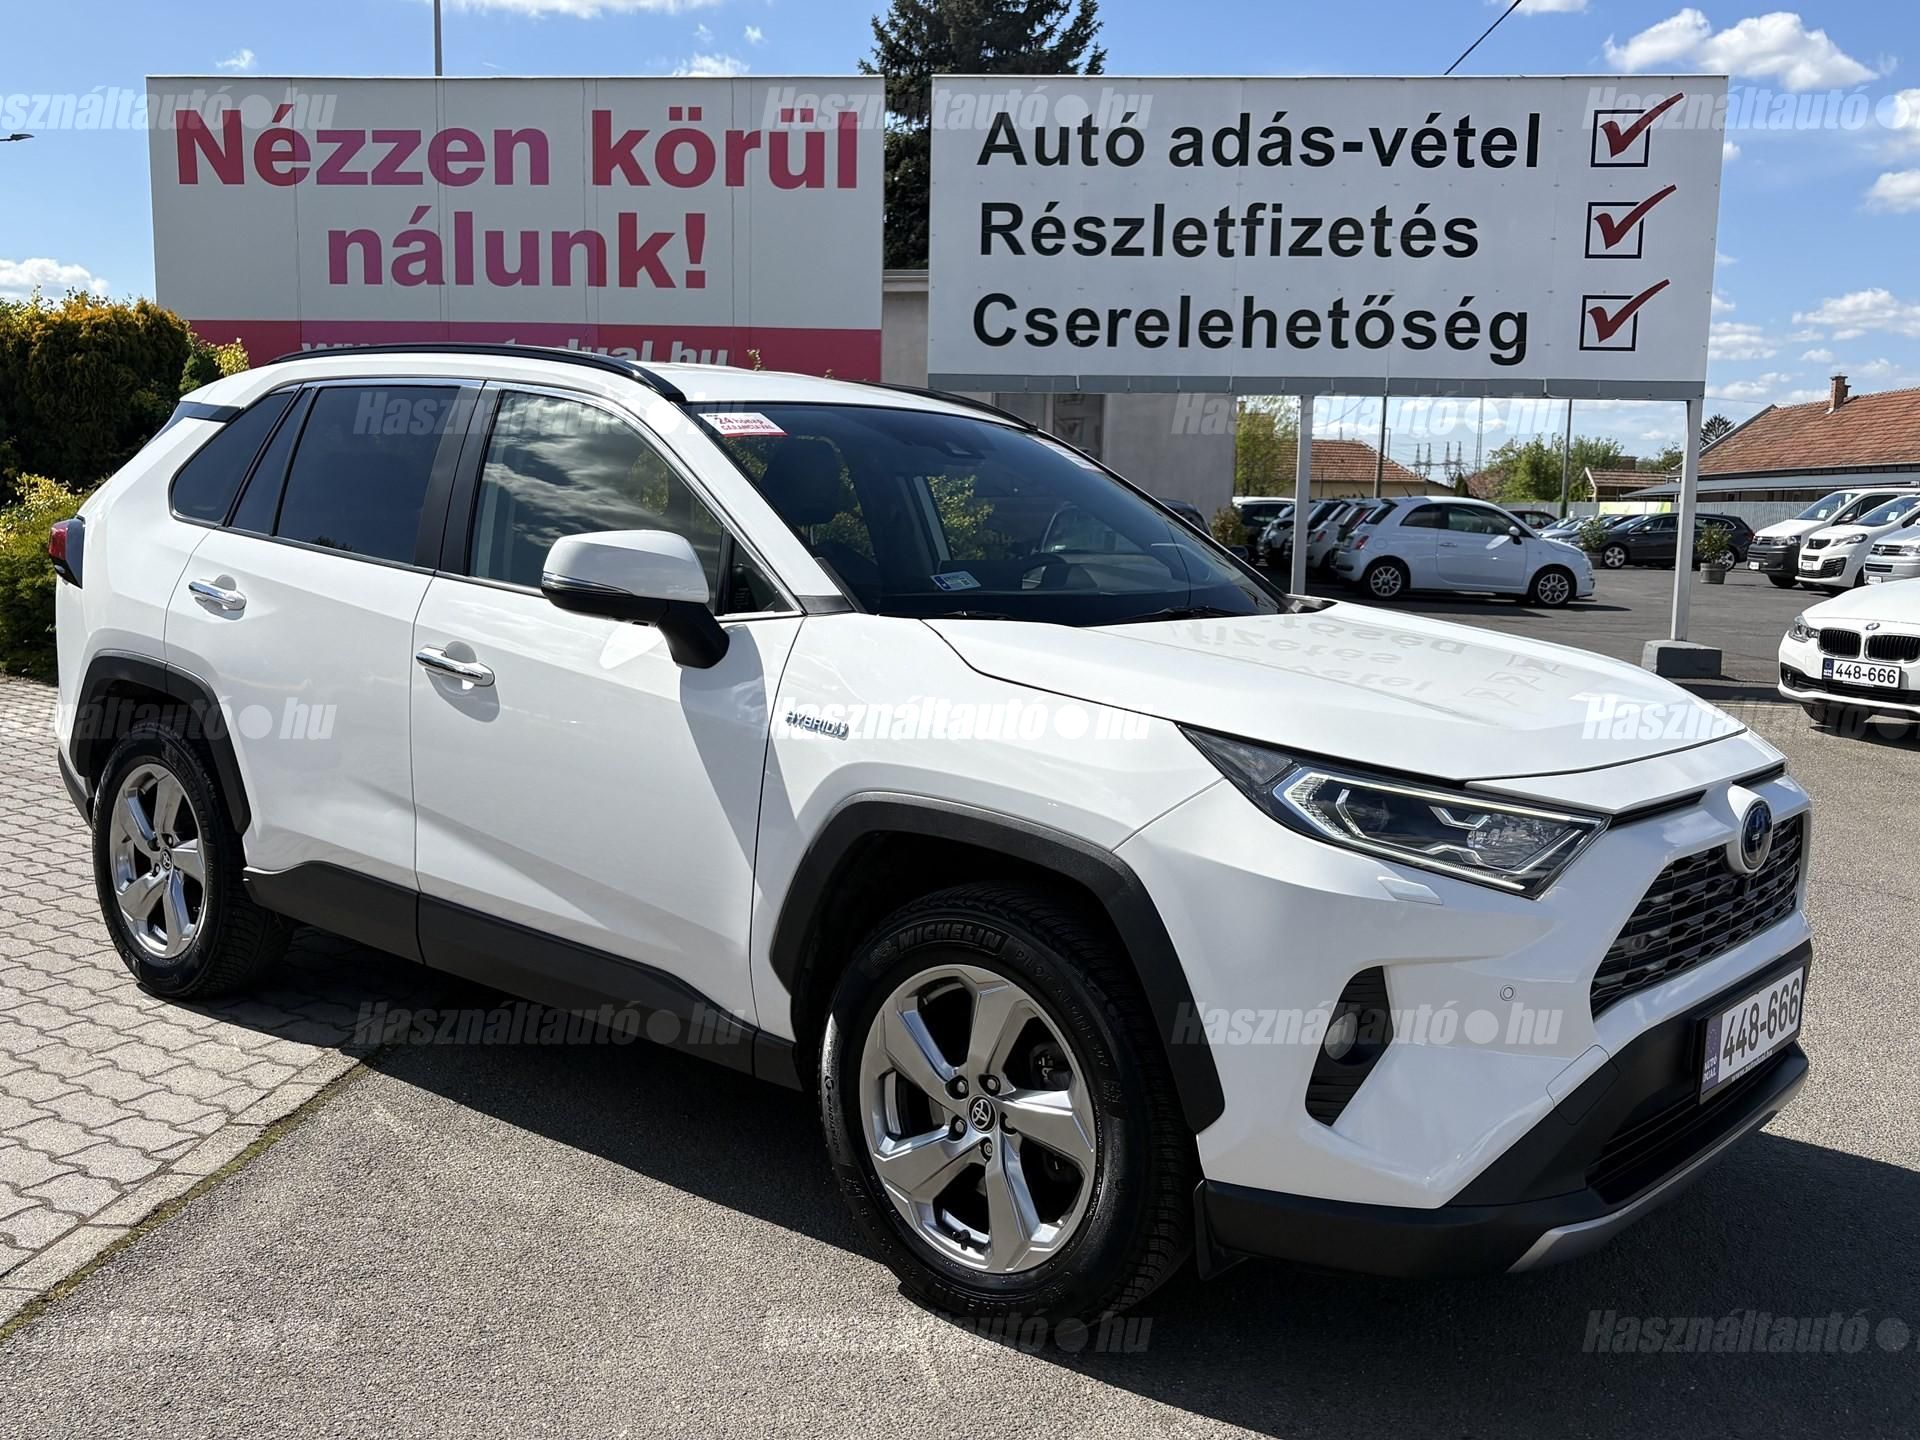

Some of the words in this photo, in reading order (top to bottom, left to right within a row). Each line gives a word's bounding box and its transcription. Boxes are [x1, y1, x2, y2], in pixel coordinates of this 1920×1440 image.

[176, 105, 549, 186] Nézzen
[593, 107, 858, 189] körül
[976, 111, 1145, 168] Autó
[1168, 111, 1541, 169] adás-vétel
[329, 206, 706, 289] nálunk!
[980, 201, 1479, 259] Részletfizetés
[973, 292, 1528, 366] Cserelehetőség
[1836, 663, 1896, 684] 448-666
[785, 711, 836, 736] HYBRID
[898, 922, 1002, 950] MICHELIN
[1722, 977, 1800, 1066] 448-666
